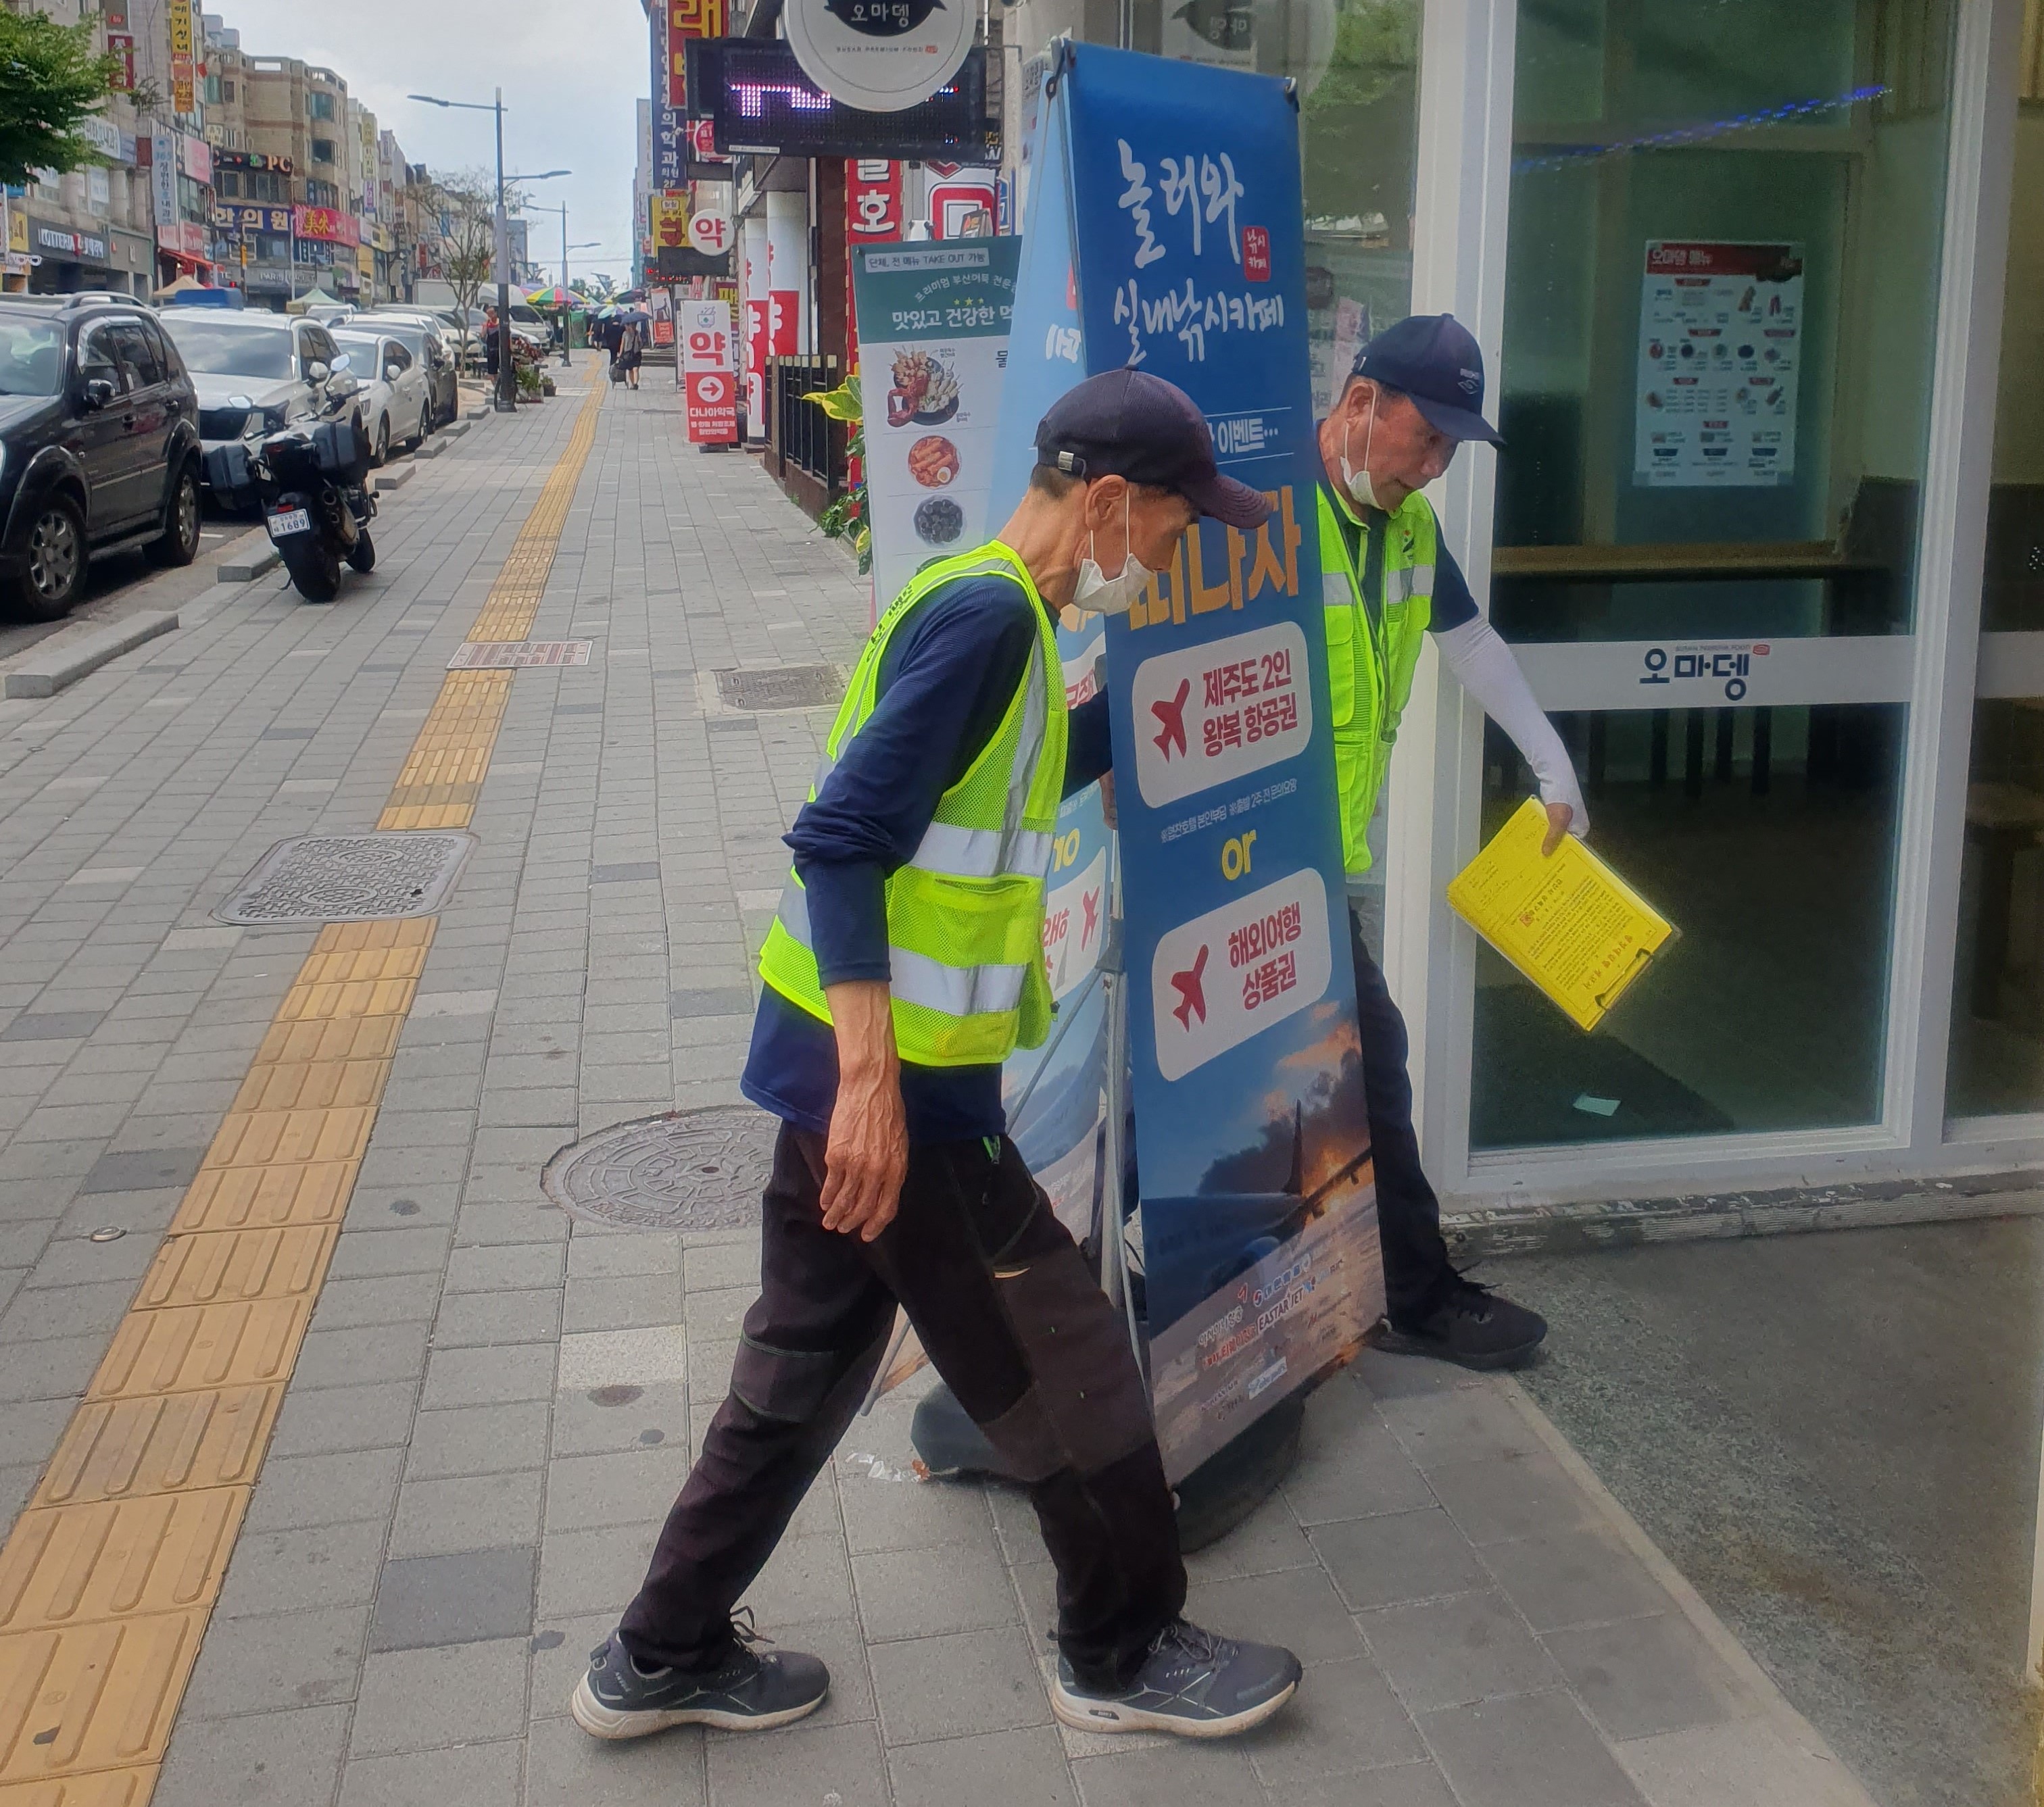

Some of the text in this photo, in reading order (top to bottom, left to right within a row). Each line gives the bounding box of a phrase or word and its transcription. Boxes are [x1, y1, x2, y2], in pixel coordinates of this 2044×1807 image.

[850, 3, 910, 27] 오마뎅
[267, 154, 291, 172] PC
[1117, 137, 1244, 269] 놀러와
[696, 218, 726, 248] 약
[1246, 228, 1265, 254] 낚시
[892, 257, 901, 268] 전
[903, 256, 919, 266] 메뉴
[924, 255, 945, 264] TAKE
[948, 254, 965, 264] OUT
[968, 253, 985, 263] 가능
[915, 276, 950, 303] 프리미엄
[892, 310, 942, 331] 맛있고
[946, 305, 995, 328] 건강한
[1113, 277, 1284, 366] 실내낚시카페
[689, 331, 726, 366] 약
[1202, 648, 1292, 709] 제주도 2인
[1639, 648, 1750, 701] 오마뎅
[1202, 692, 1298, 758] 왕복 항공권
[1222, 830, 1257, 881] or
[1227, 901, 1302, 968] 해외여행
[1242, 949, 1298, 1011] 상품권
